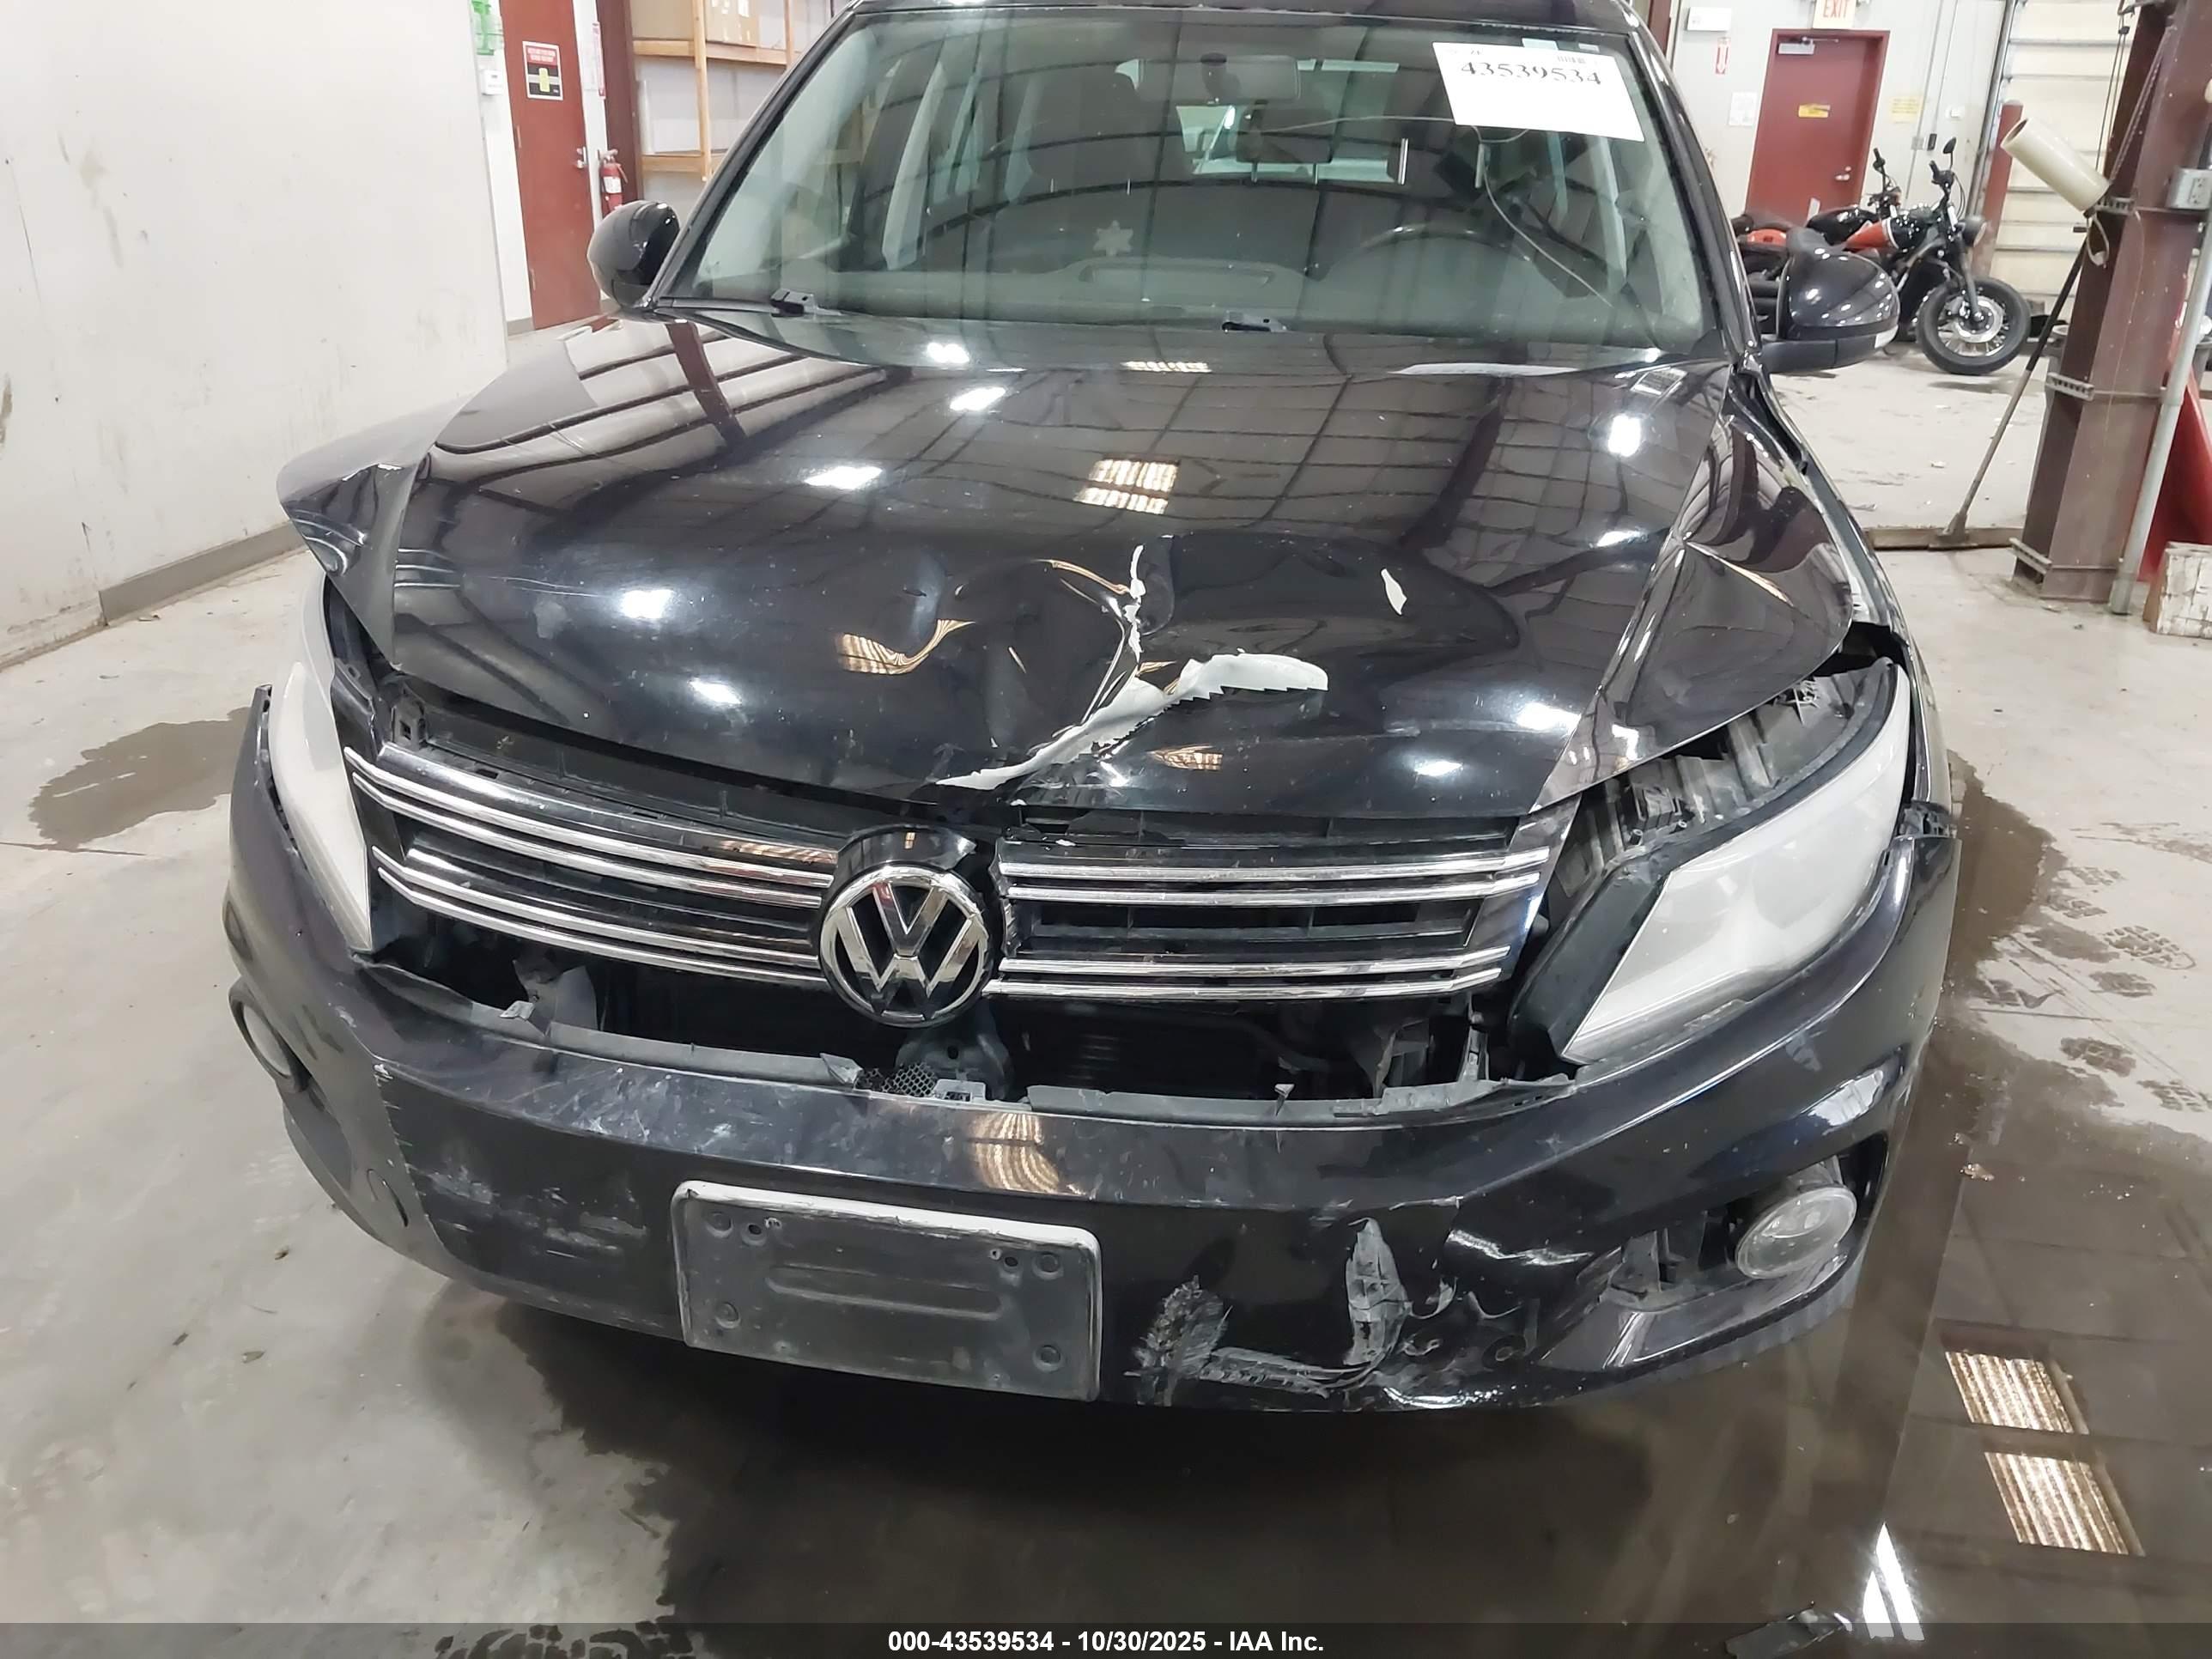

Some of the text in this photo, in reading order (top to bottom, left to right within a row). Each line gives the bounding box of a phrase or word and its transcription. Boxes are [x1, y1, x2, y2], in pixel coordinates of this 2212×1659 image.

[1822, 0, 1850, 18] EXIT
[1461, 62, 1602, 84] 43539534
[824, 867, 988, 1022] VW
